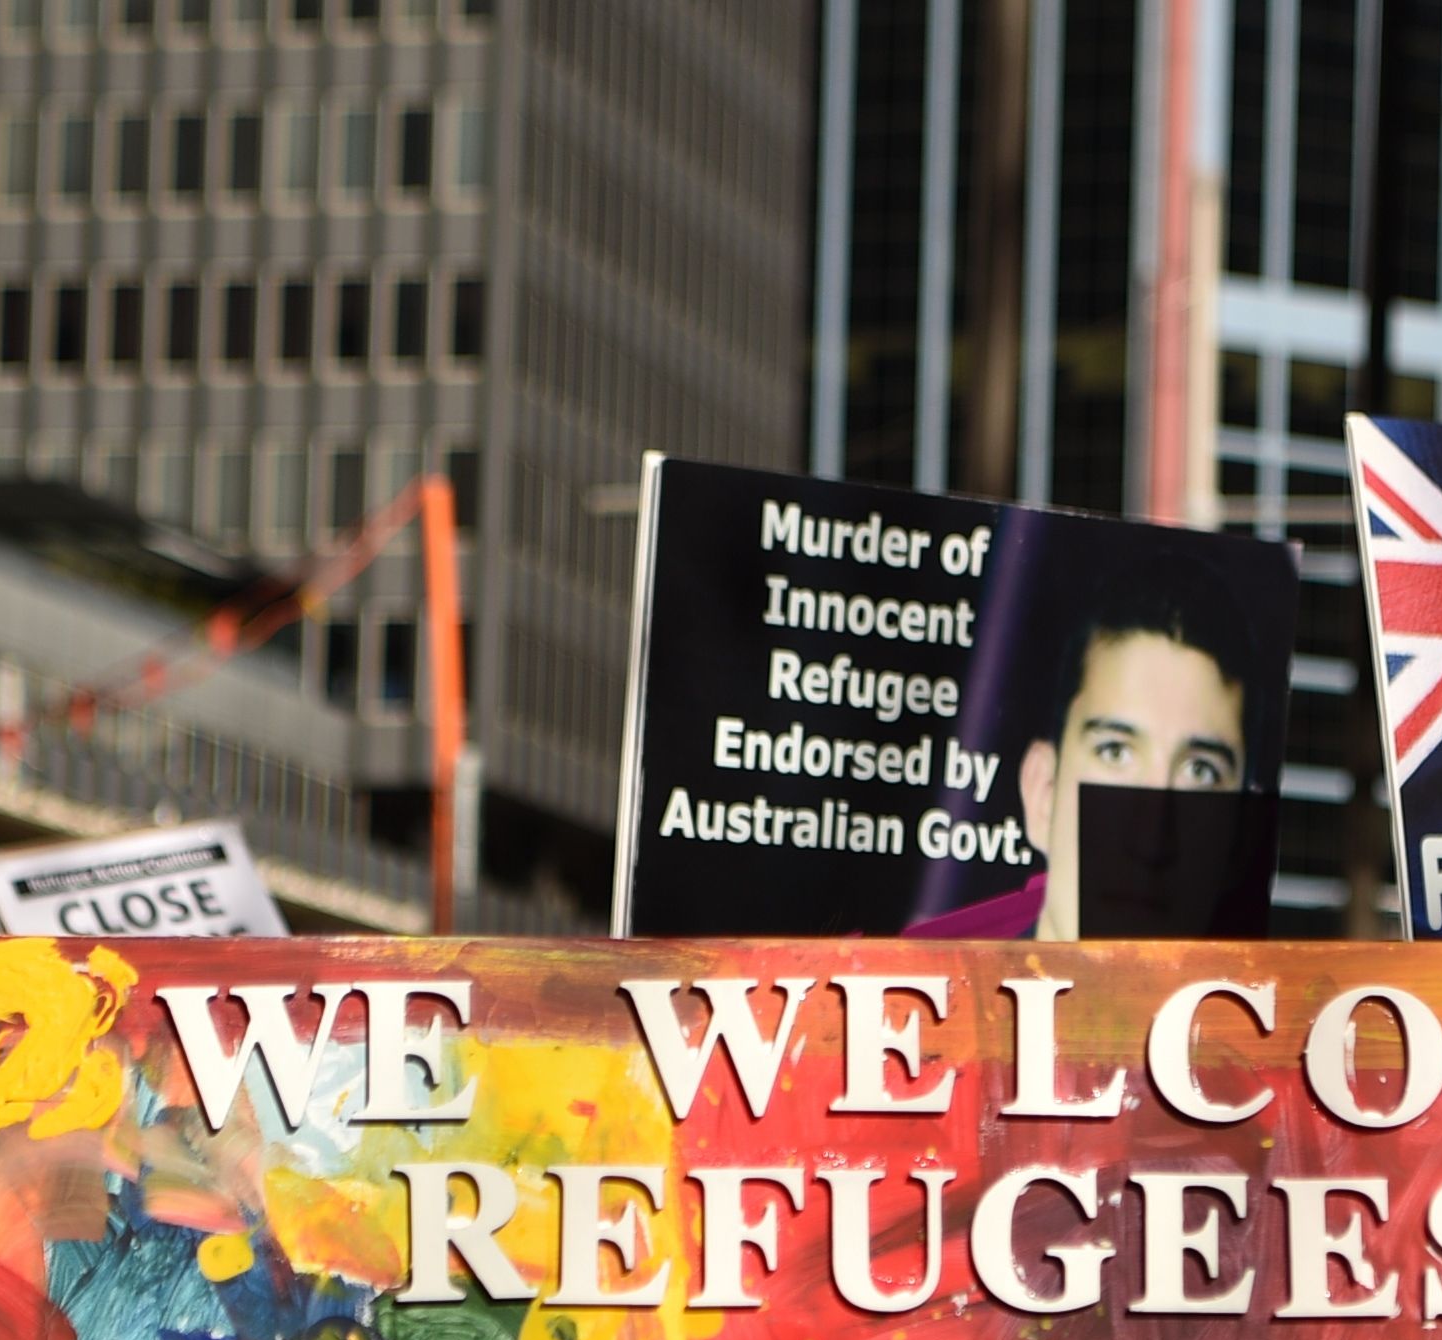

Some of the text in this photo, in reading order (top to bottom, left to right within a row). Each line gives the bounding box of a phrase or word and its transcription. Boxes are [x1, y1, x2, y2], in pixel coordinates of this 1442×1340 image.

[761, 500, 991, 578] Murder of
[763, 576, 975, 648] Innocent
[769, 650, 958, 723] Refugee
[713, 718, 999, 802] Endorsed by
[660, 788, 1033, 865] Australian Govt.
[58, 879, 224, 935] CLOSE
[155, 979, 475, 1132] WE
